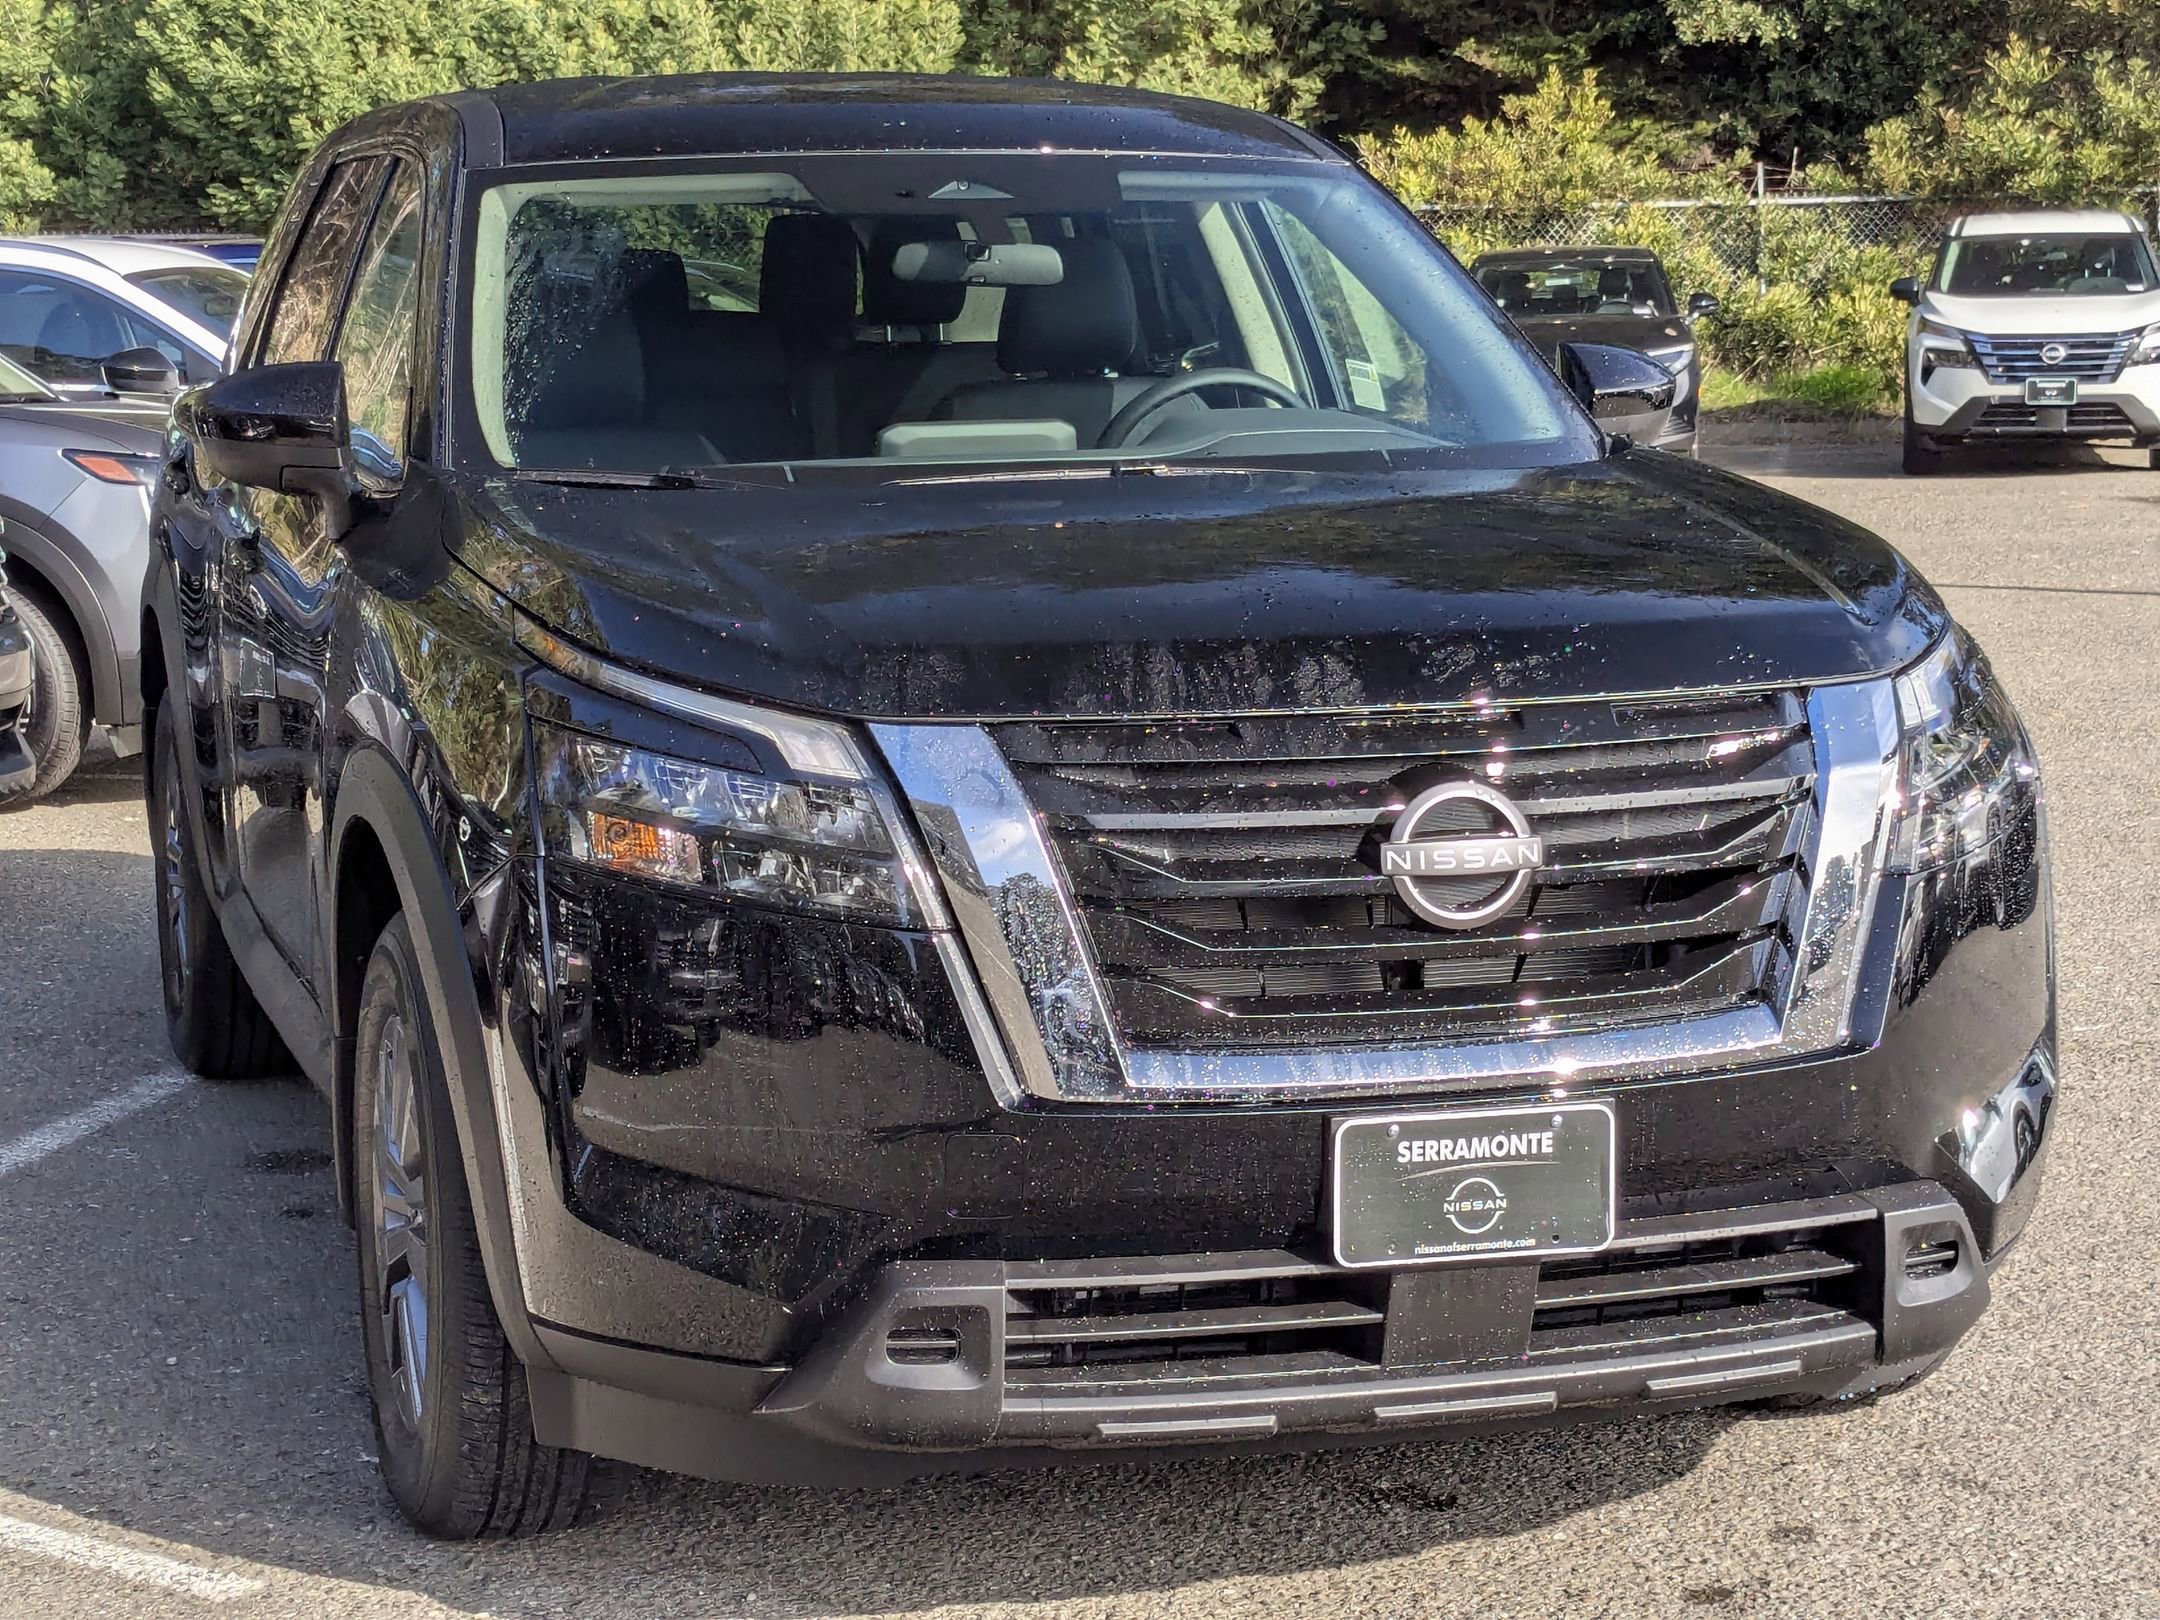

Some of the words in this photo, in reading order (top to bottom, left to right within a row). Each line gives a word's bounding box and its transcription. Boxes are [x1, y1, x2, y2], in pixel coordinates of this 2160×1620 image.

[1386, 843, 1539, 870] NISSAN
[1397, 1131, 1554, 1163] SERRAMONTE
[1443, 1198, 1507, 1213] NISSAN
[1414, 1238, 1536, 1255] nissanofserramonte.com
